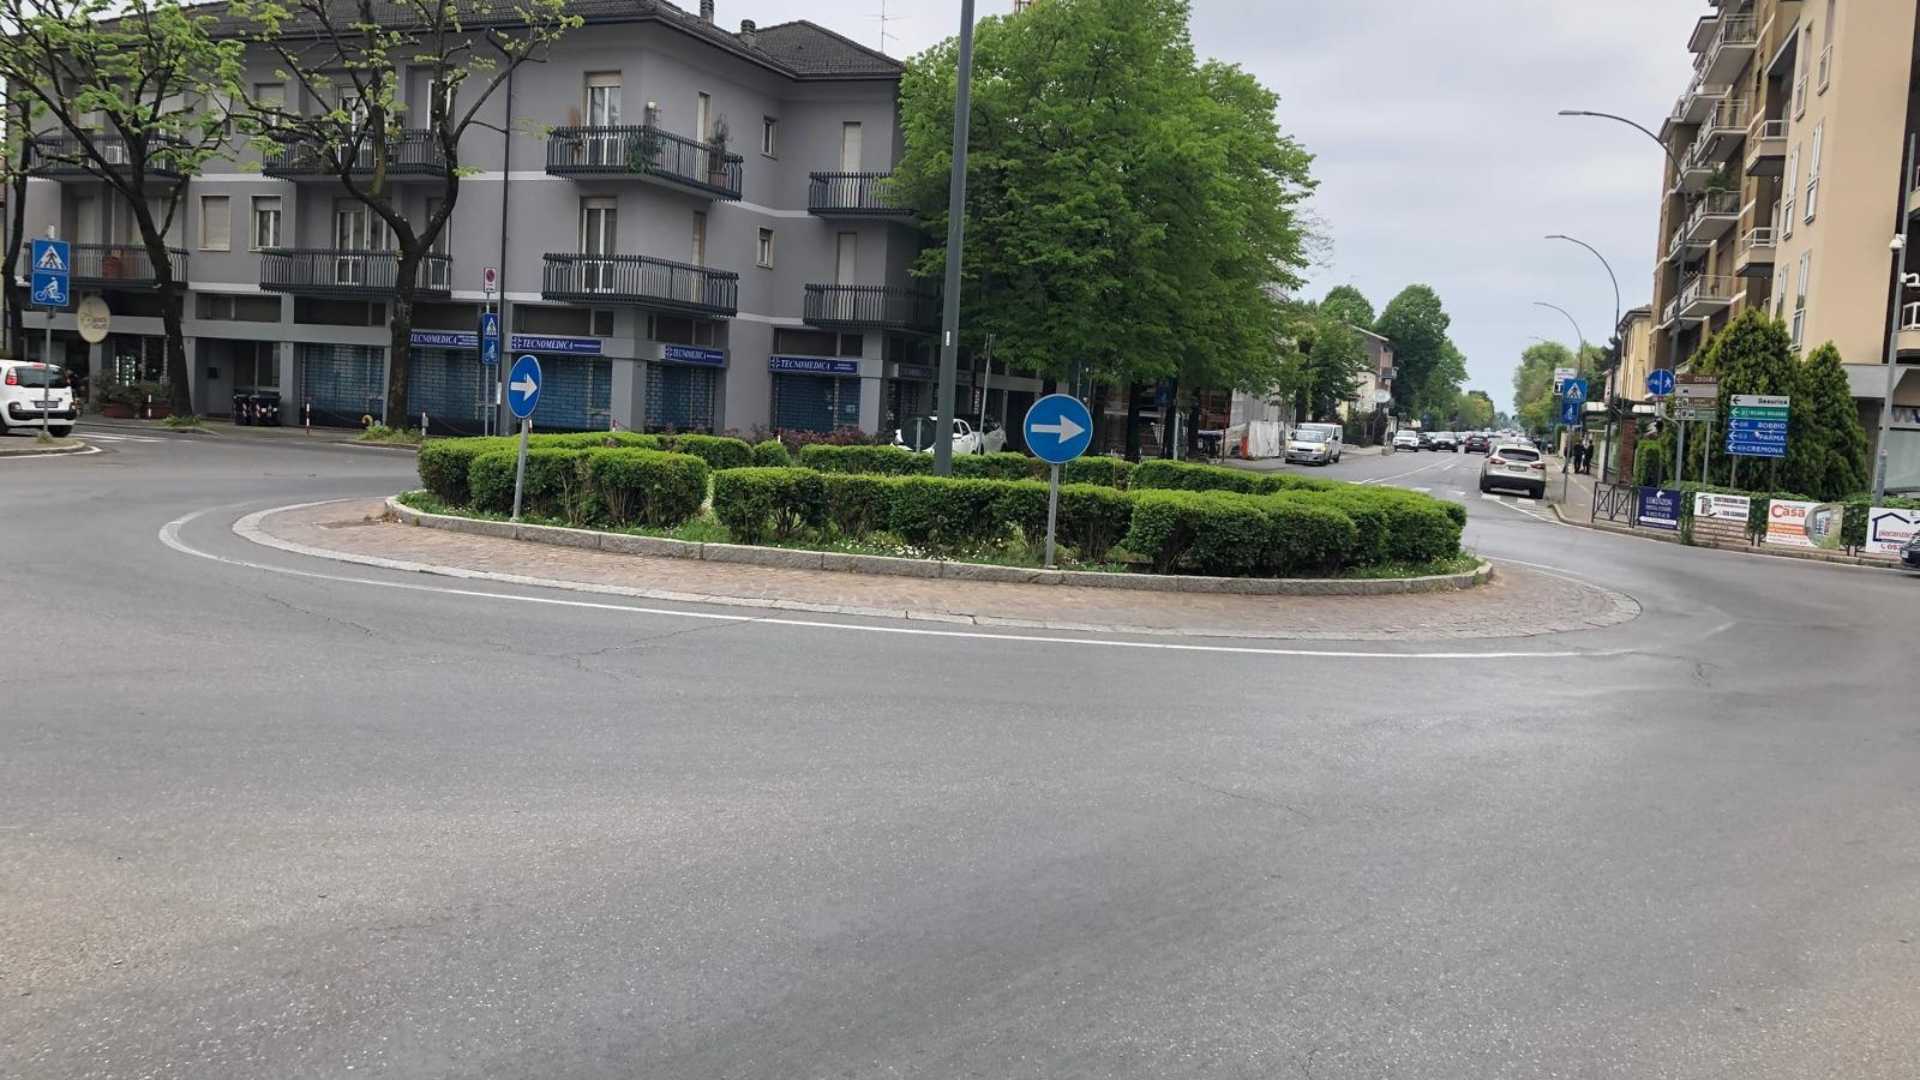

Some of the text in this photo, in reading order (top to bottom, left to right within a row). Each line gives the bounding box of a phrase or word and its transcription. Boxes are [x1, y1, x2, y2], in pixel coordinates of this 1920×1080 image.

[410, 334, 457, 345] TECNOMEDICA
[522, 337, 574, 349] TECNOMEDICA
[673, 348, 707, 360] TECNOMEDICA
[781, 359, 831, 370] TECNOMEDICA
[1747, 445, 1784, 453] CREMONA
[1771, 504, 1806, 518] Casa
